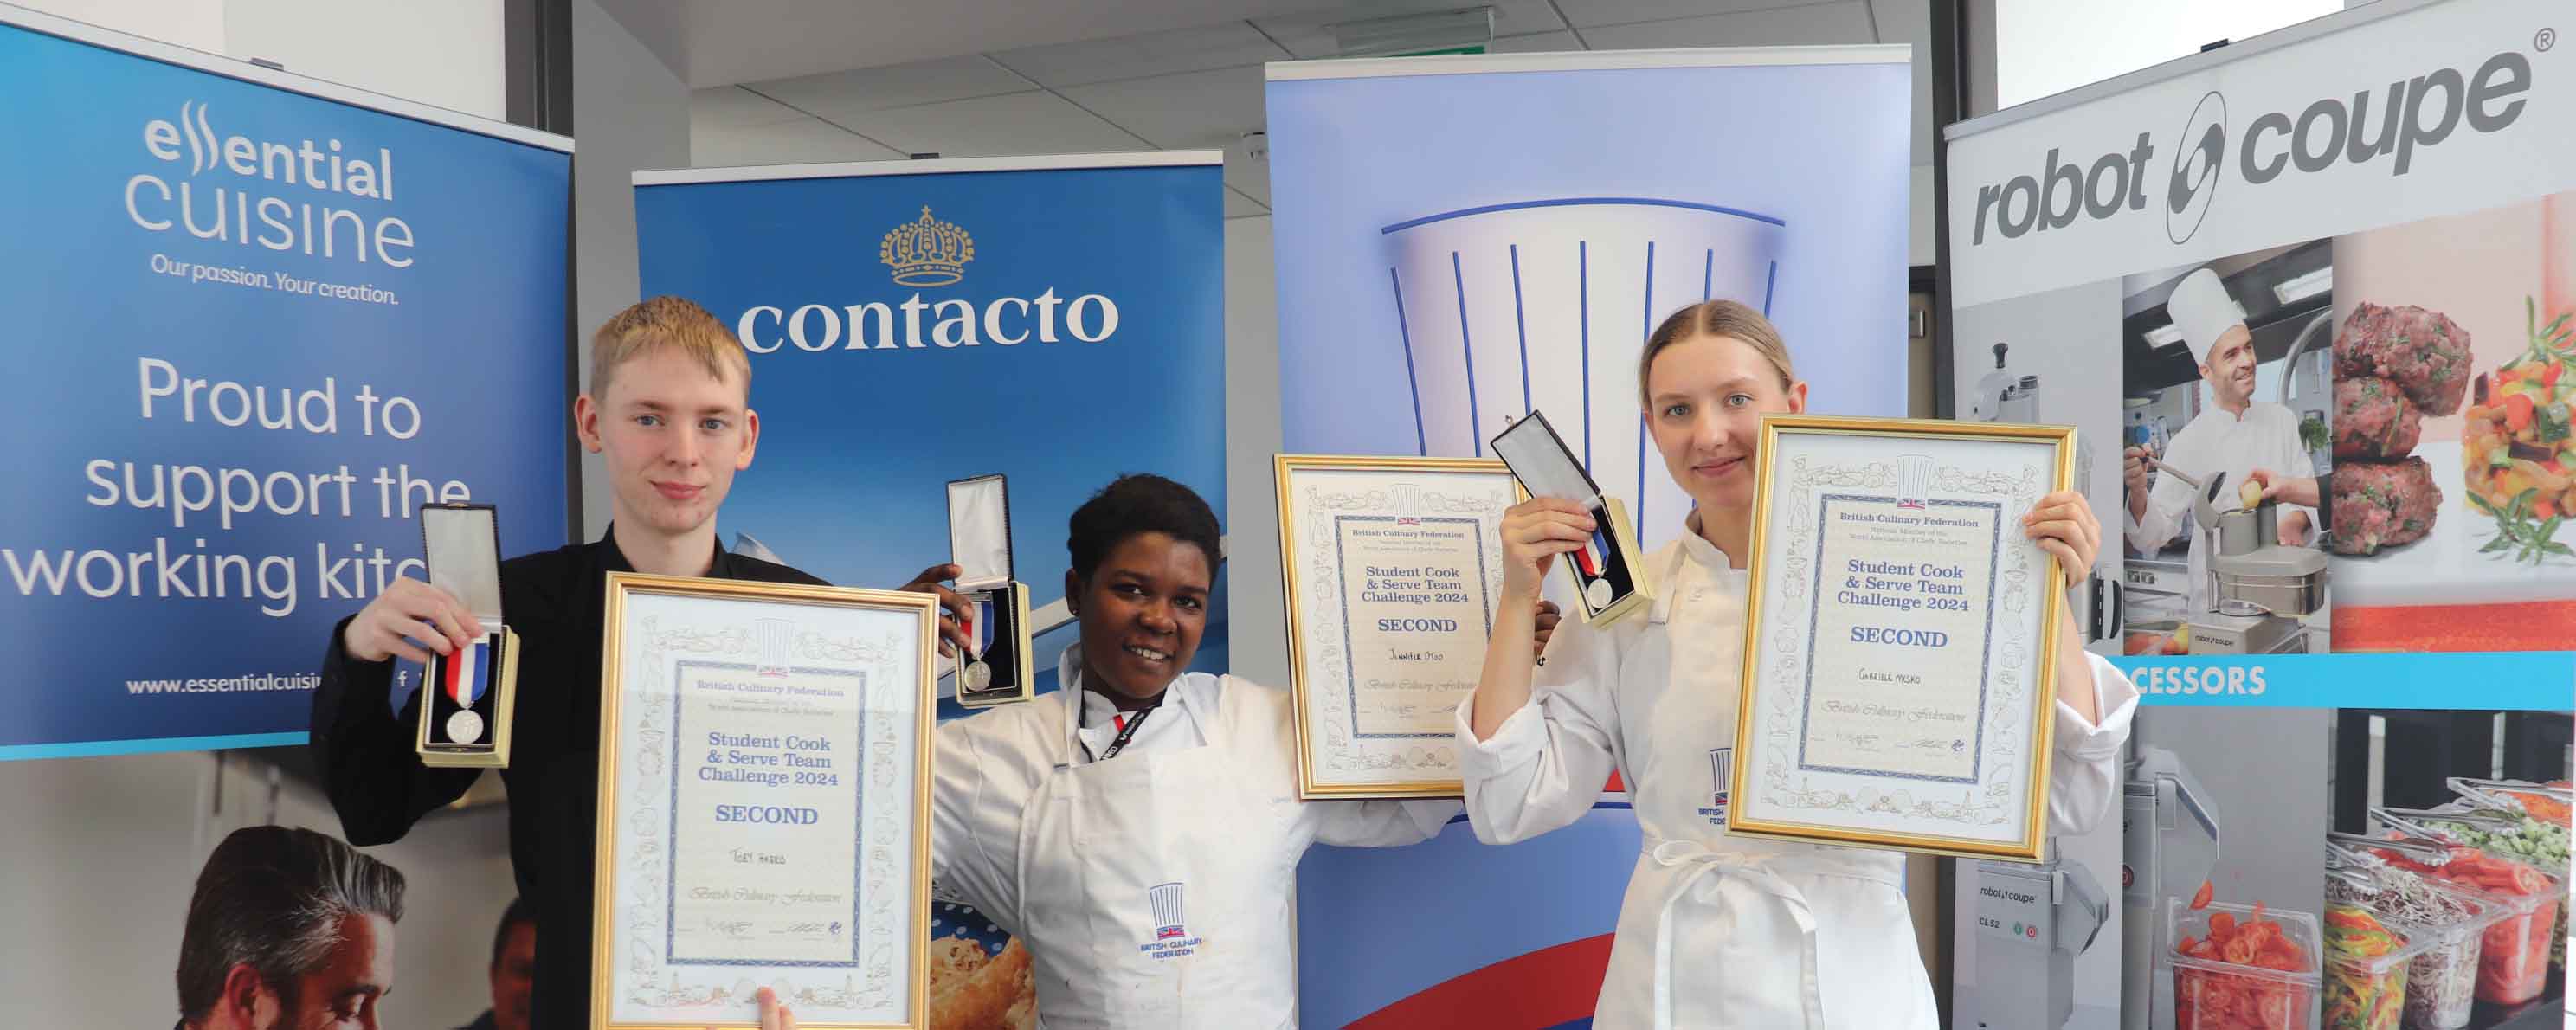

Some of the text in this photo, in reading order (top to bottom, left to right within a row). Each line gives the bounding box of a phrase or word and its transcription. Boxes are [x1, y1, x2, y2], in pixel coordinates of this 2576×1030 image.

[1973, 49, 2533, 246] robot coupe
[151, 254, 399, 306] Our passion. Your creation.
[737, 286, 1119, 354] contacto
[138, 356, 422, 440] Proud to
[86, 458, 471, 530] support the
[1839, 512, 1980, 528] British Culinary Federation
[1352, 529, 1465, 540] British Culinary Federation
[2, 537, 298, 617] working
[1365, 565, 1460, 578] Student Cook
[1847, 559, 1964, 579] Student Cook
[1366, 579, 1462, 590] & Serve Team
[1845, 576, 1963, 595] & Serve Team
[1362, 591, 1469, 605] Challenge 2024
[1837, 591, 1969, 612] Challenge 2024
[1378, 618, 1458, 633] SECOND
[1851, 626, 1948, 647] SECOND
[697, 679, 844, 698] British Culinary Federation
[2121, 666, 2266, 695] CESSORS
[708, 731, 831, 751] Student Cook
[706, 750, 831, 769] & Serve Team
[699, 767, 839, 786] Challenge 2024
[715, 804, 818, 825] SECOND
[1980, 886, 2035, 904] robot coupe
[1140, 937, 1202, 952] BRITISH CULINARY
[1152, 948, 1194, 959] FEDERATION
